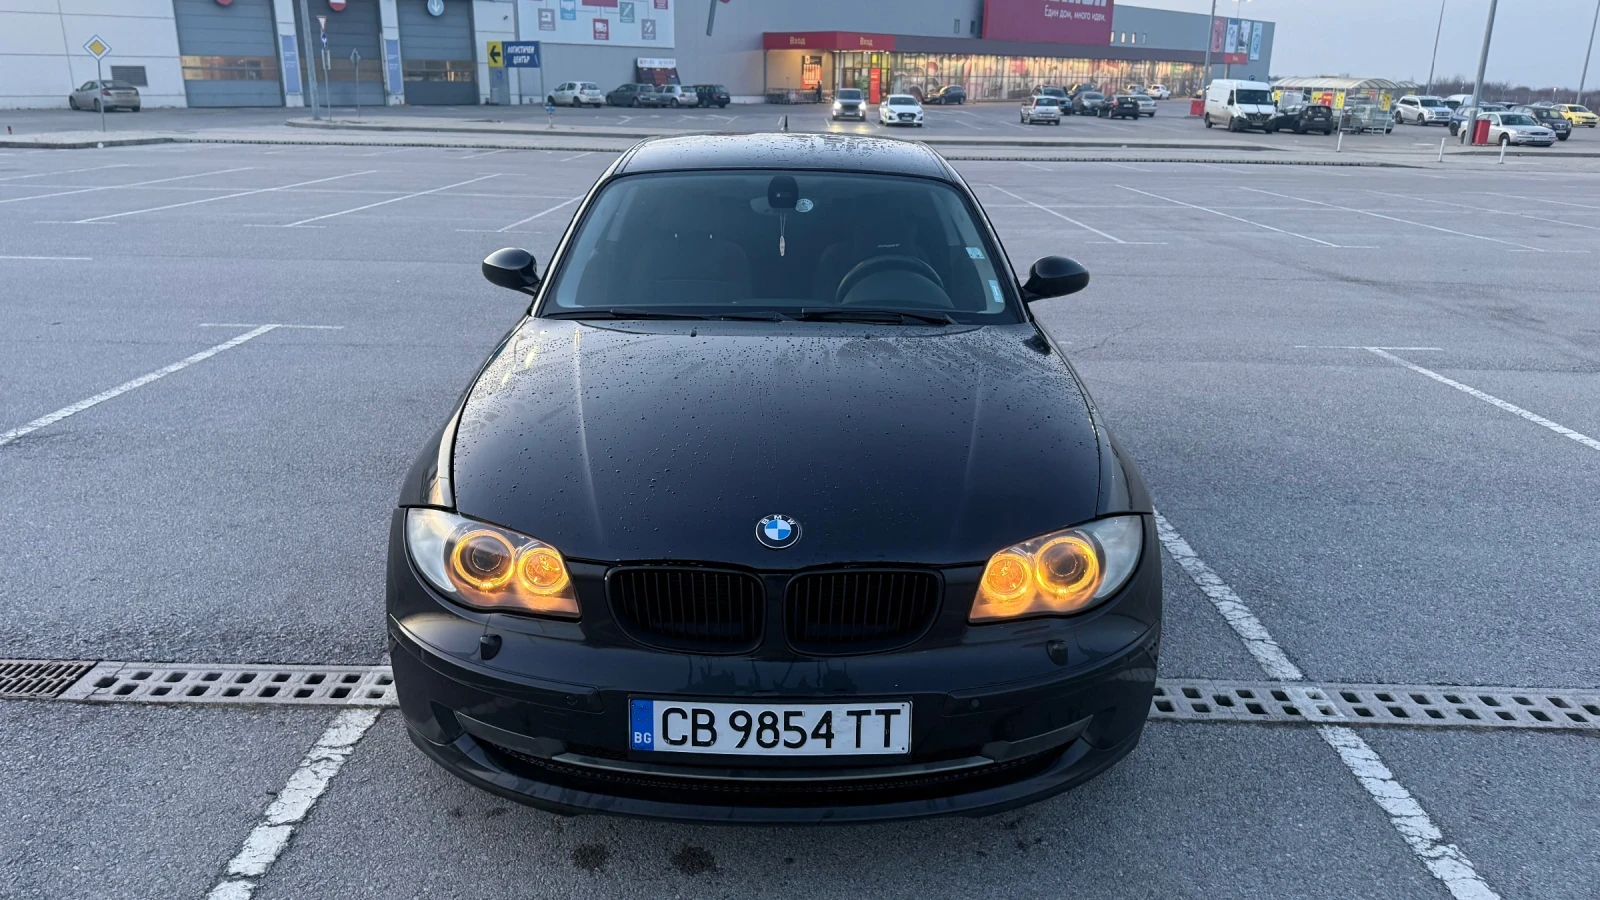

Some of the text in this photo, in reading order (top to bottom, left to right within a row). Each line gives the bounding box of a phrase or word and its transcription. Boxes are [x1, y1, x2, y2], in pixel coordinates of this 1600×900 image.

[1044, 4, 1059, 18] Един
[1074, 11, 1091, 20] много
[789, 36, 806, 45] Вход
[859, 36, 873, 46] Вход
[760, 514, 796, 525] BMW
[662, 707, 901, 749] CB 9854 TT
[634, 731, 652, 744] BG
